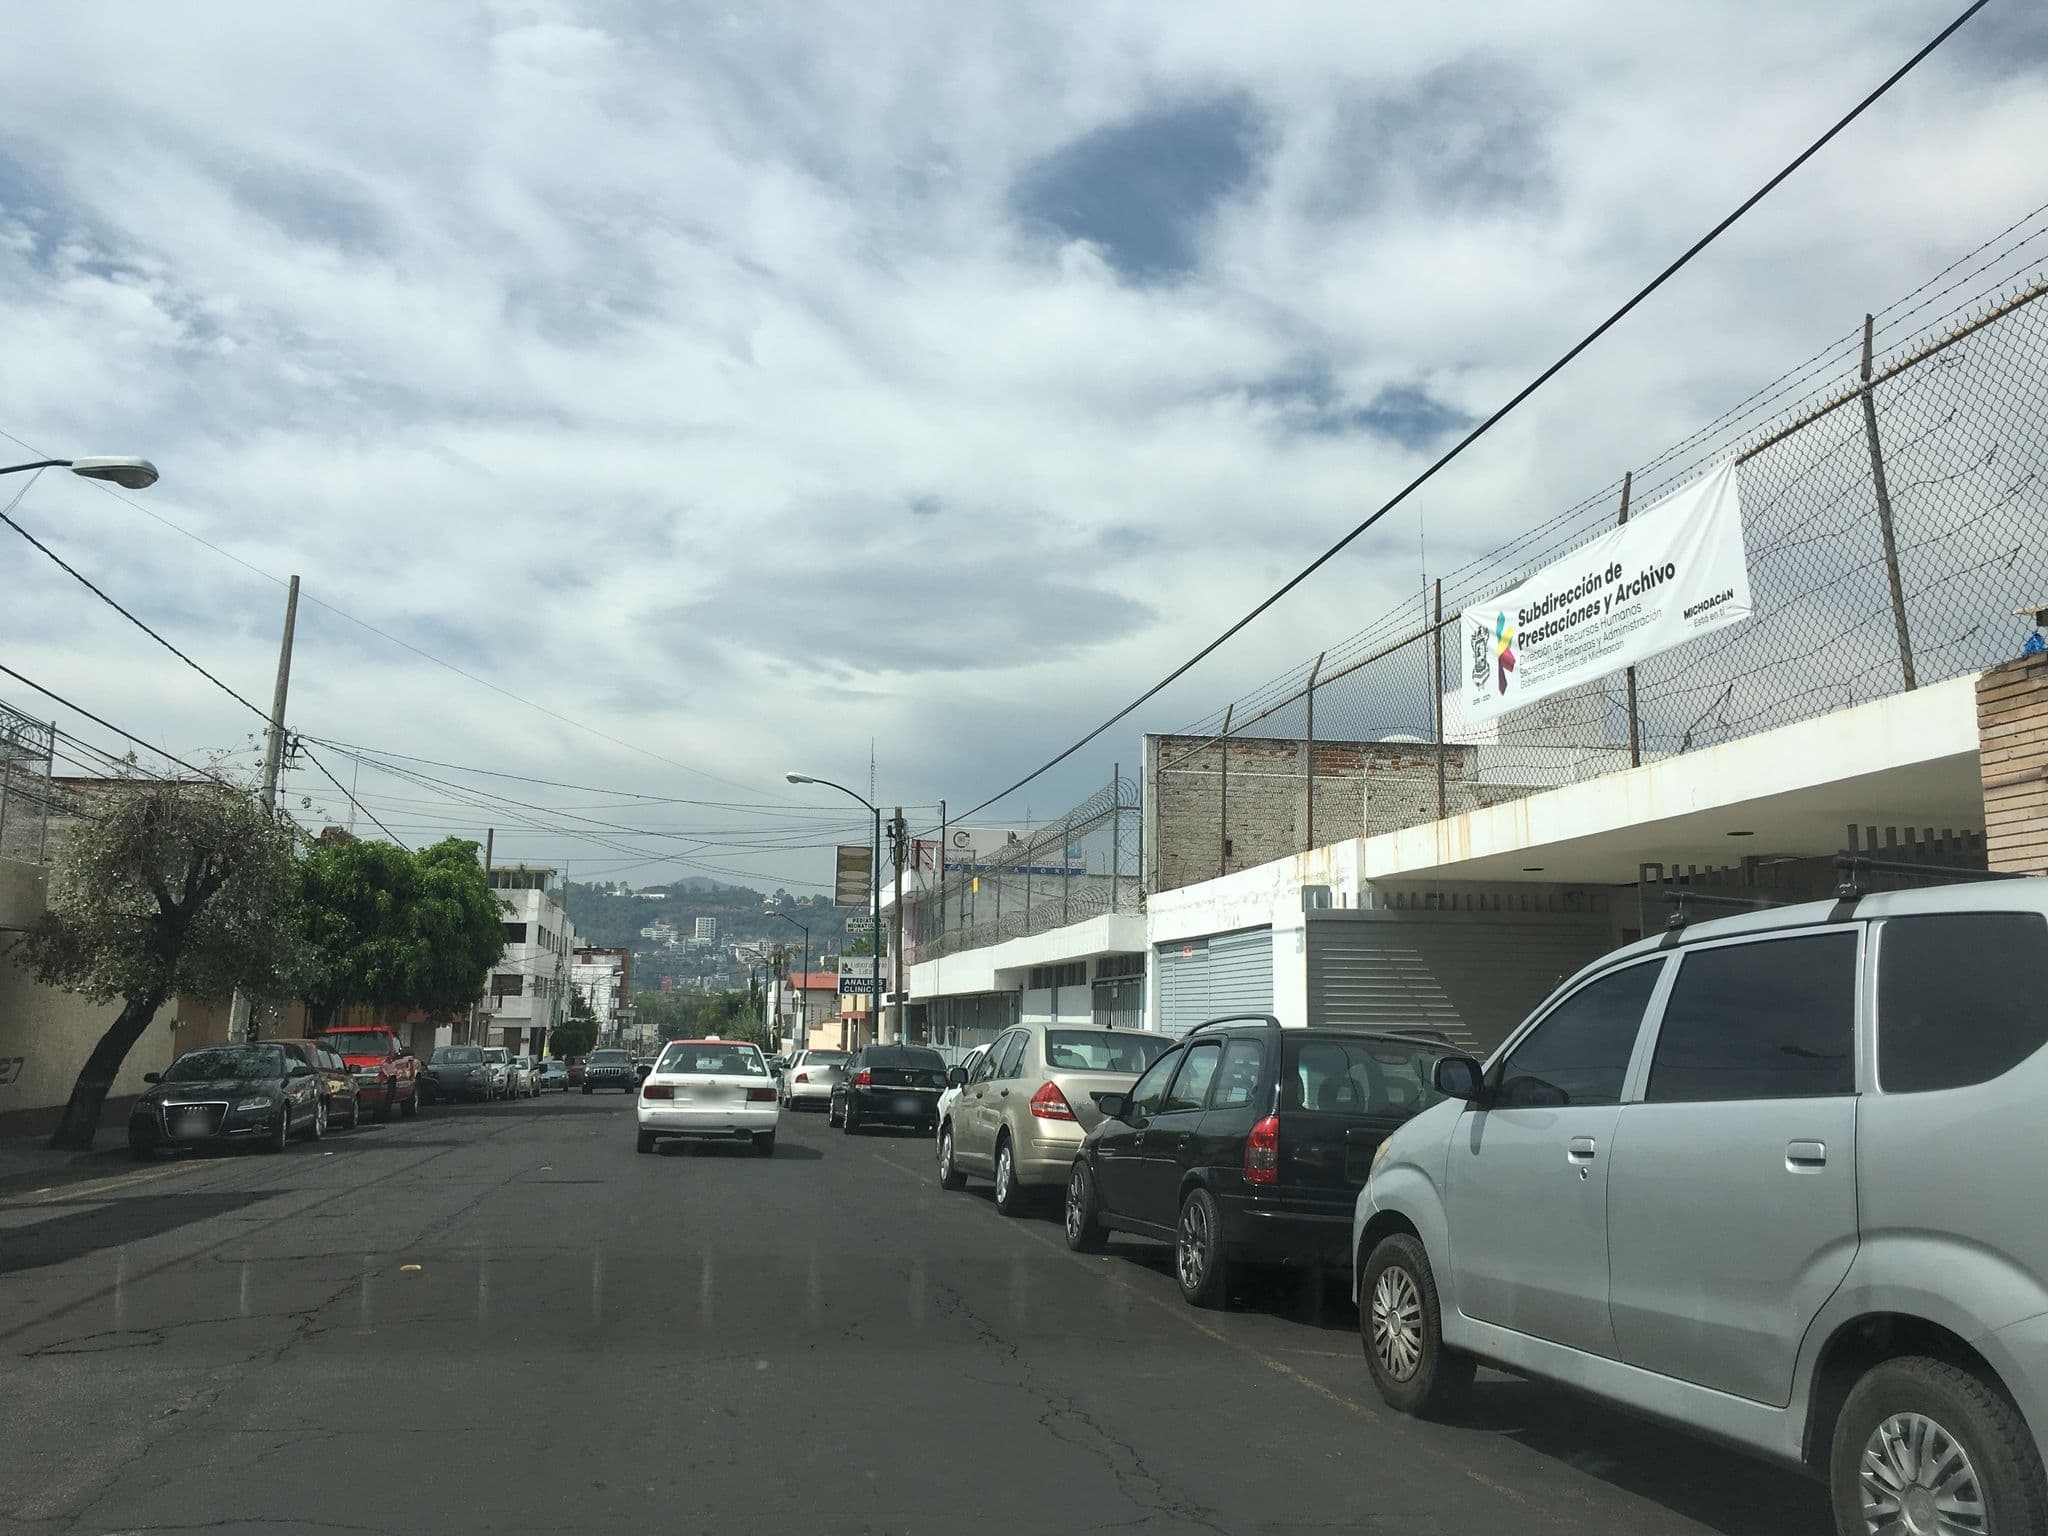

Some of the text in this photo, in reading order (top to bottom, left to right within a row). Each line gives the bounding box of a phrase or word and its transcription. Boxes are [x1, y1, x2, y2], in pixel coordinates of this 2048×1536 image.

[1518, 561, 1622, 627] Subdirección de
[1518, 563, 1676, 650] Prestaciones y Archivo
[1553, 640, 1562, 651] de
[1564, 623, 1599, 643] Recursos
[1601, 603, 1642, 628] Humanos
[1604, 608, 1662, 641] Administración
